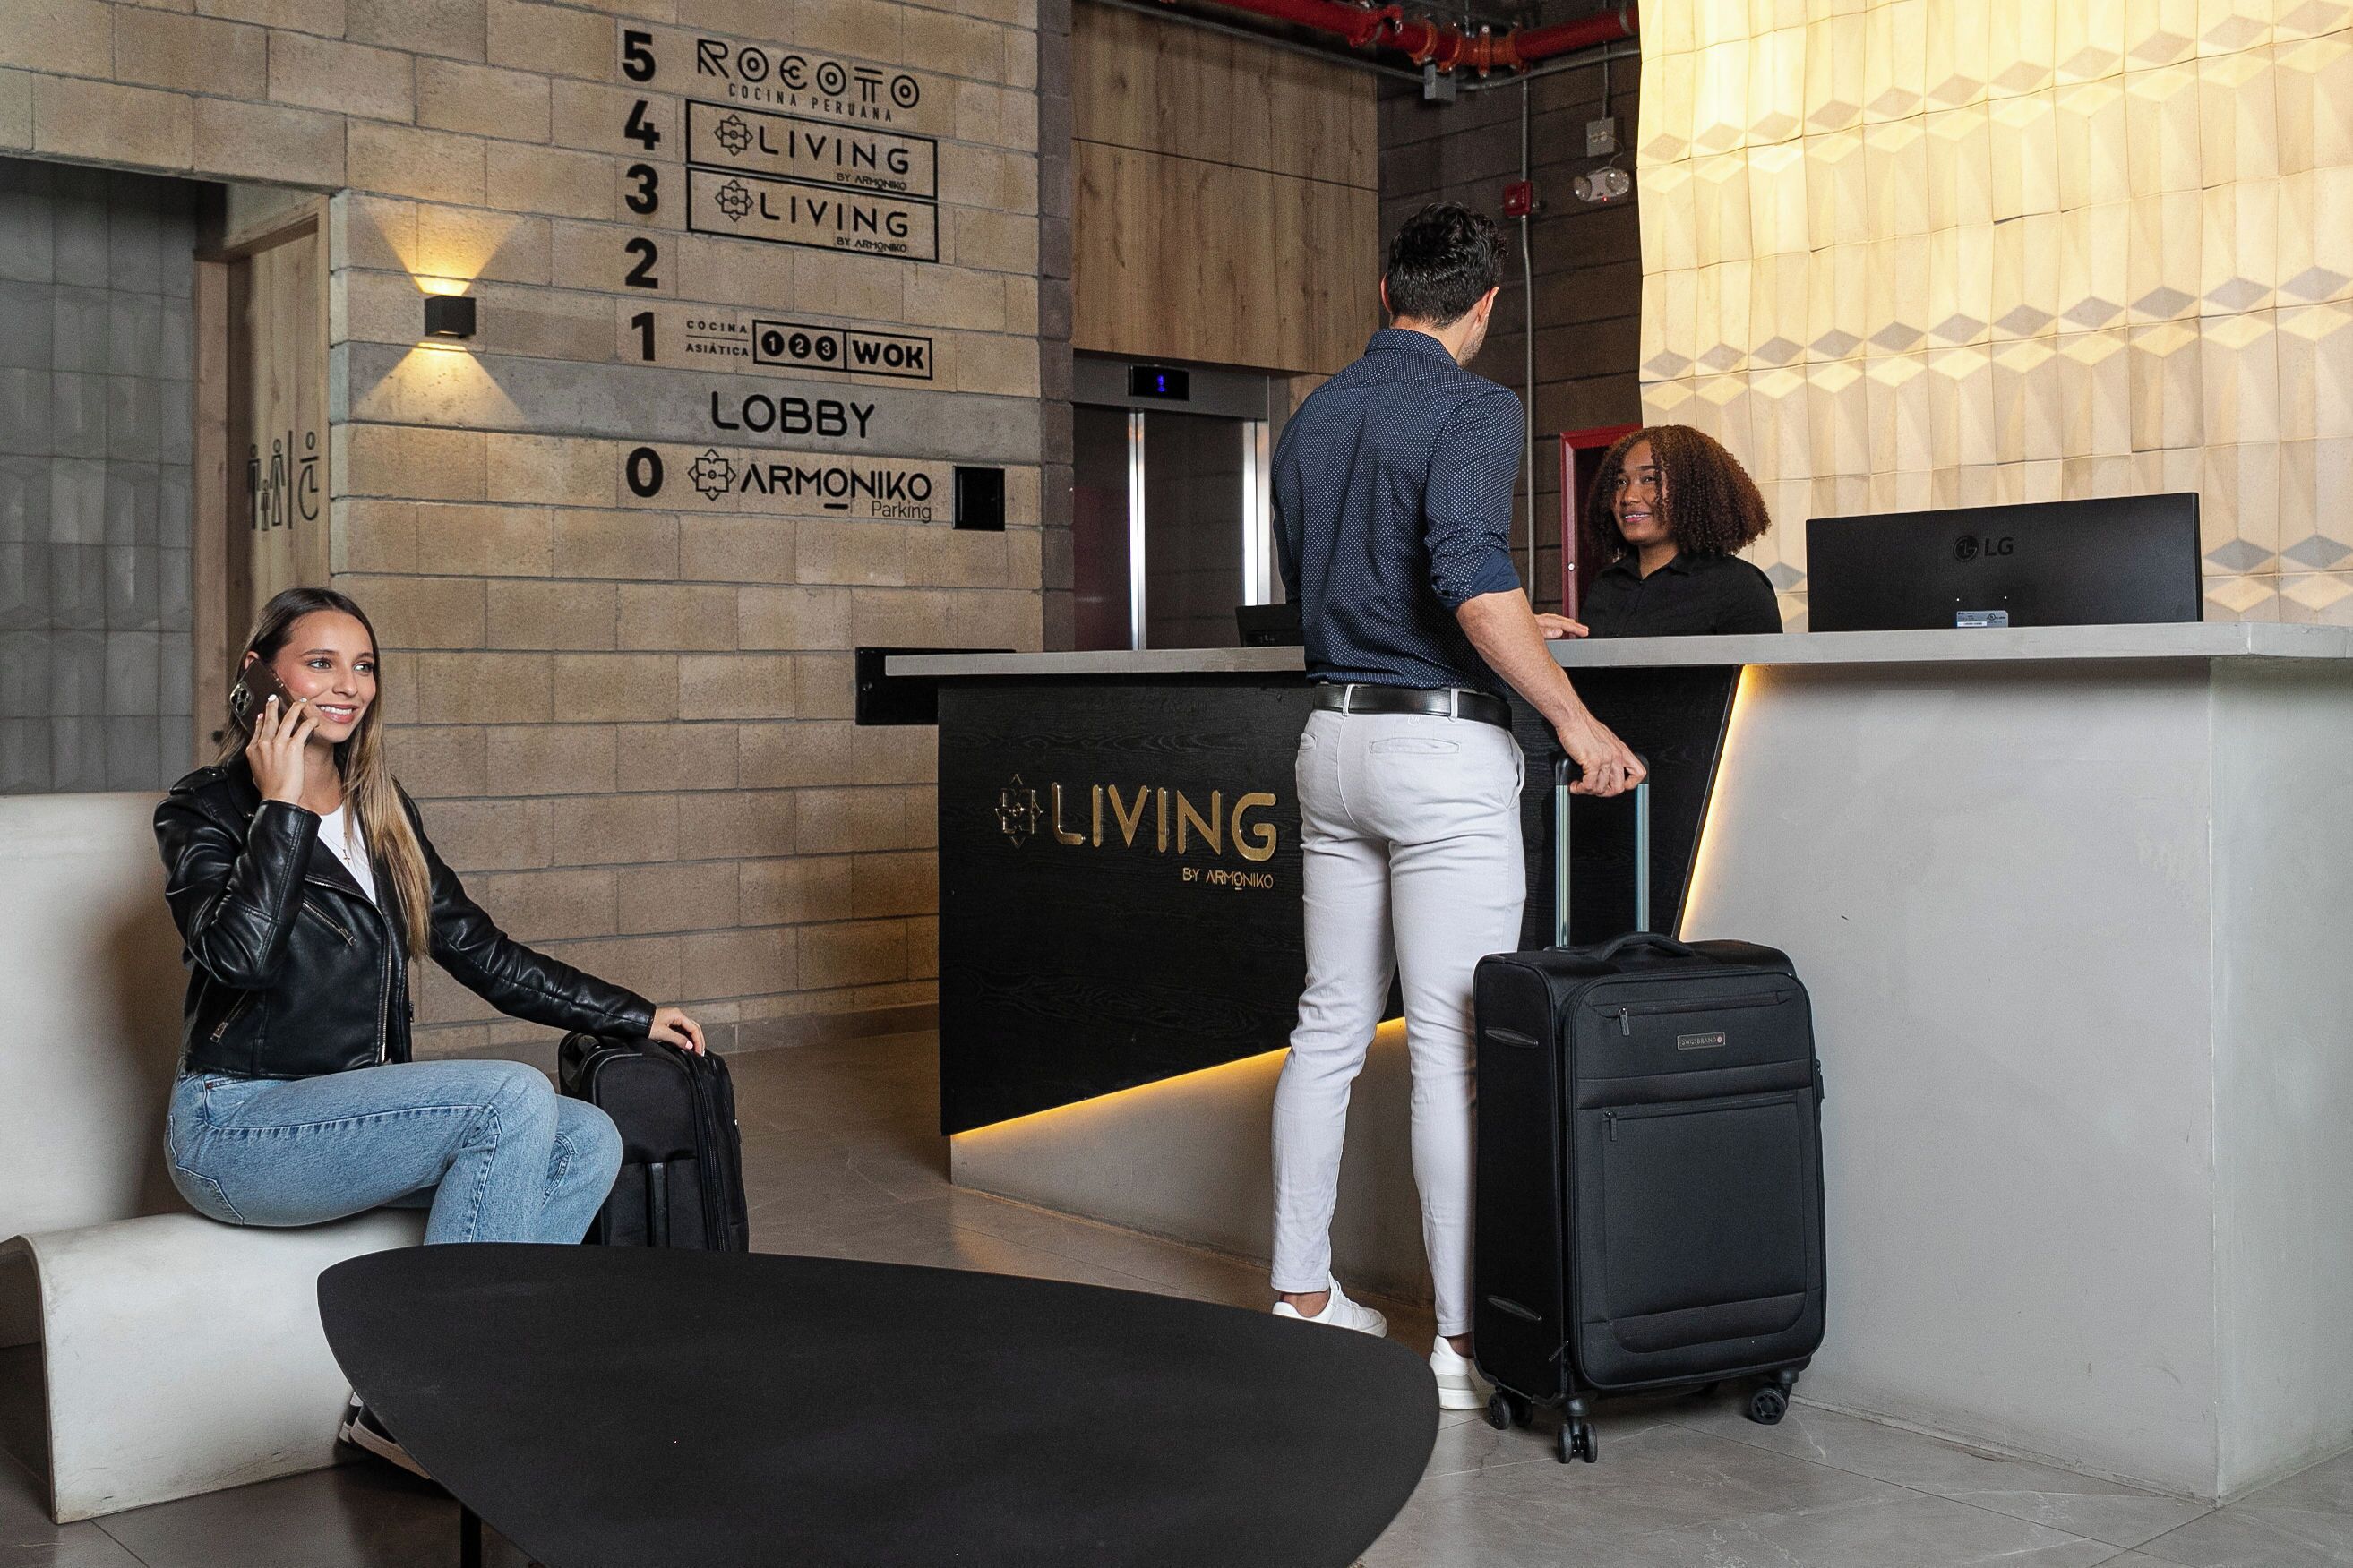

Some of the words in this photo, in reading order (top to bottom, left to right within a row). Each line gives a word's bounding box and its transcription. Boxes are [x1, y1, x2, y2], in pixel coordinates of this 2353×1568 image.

[623, 30, 656, 82] 5
[624, 100, 660, 150] 4
[729, 83, 797, 107] COCINA
[812, 97, 892, 123] PERUANA
[759, 126, 909, 174] LIVING
[625, 163, 658, 216] 3
[837, 172, 851, 182] BY
[760, 192, 908, 238] LIVING
[625, 237, 658, 288] 2
[837, 236, 850, 246] BY
[631, 311, 656, 362] 1
[685, 343, 749, 357] ASIÁTICA
[686, 319, 748, 335] COCINA
[852, 340, 925, 370] WOK
[711, 391, 875, 439] LOBBY
[626, 447, 664, 499] 0
[740, 463, 932, 510] ARMONIKO
[871, 501, 932, 523] Parking
[1984, 537, 2014, 556] LG
[1052, 782, 1277, 861] LIVING
[1182, 867, 1201, 882] BY
